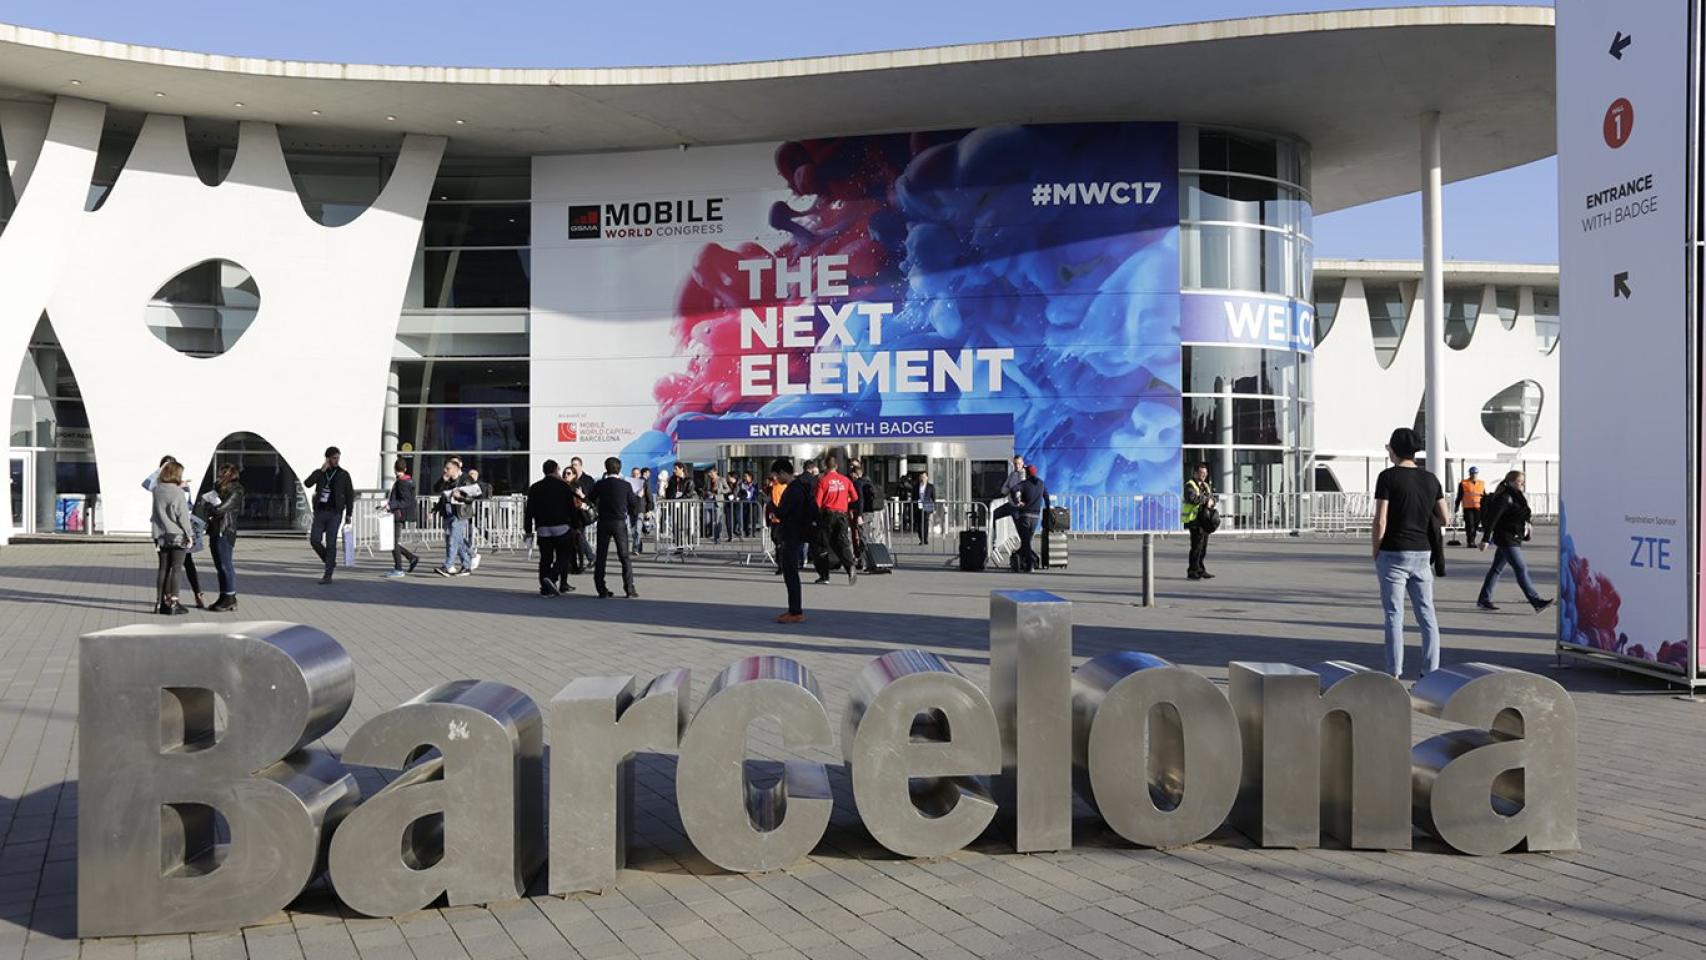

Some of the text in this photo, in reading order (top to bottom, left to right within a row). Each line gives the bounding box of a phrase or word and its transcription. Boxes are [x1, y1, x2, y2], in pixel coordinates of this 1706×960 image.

[1614, 114, 1621, 140] 1
[1031, 182, 1162, 206] #MWC17
[1586, 174, 1653, 209] ENTRANCE
[605, 198, 724, 227] MOBILE
[1582, 196, 1658, 233] WITH BADGE
[606, 224, 724, 239] WORLD CONGRESS
[738, 254, 849, 300] THE
[741, 303, 893, 349] NEXT
[741, 348, 1014, 396] ELEMENT
[750, 421, 934, 437] ENTRANCE WITH BADGE
[1630, 536, 1671, 570] ZTE
[78, 590, 1580, 938] Barcelona
